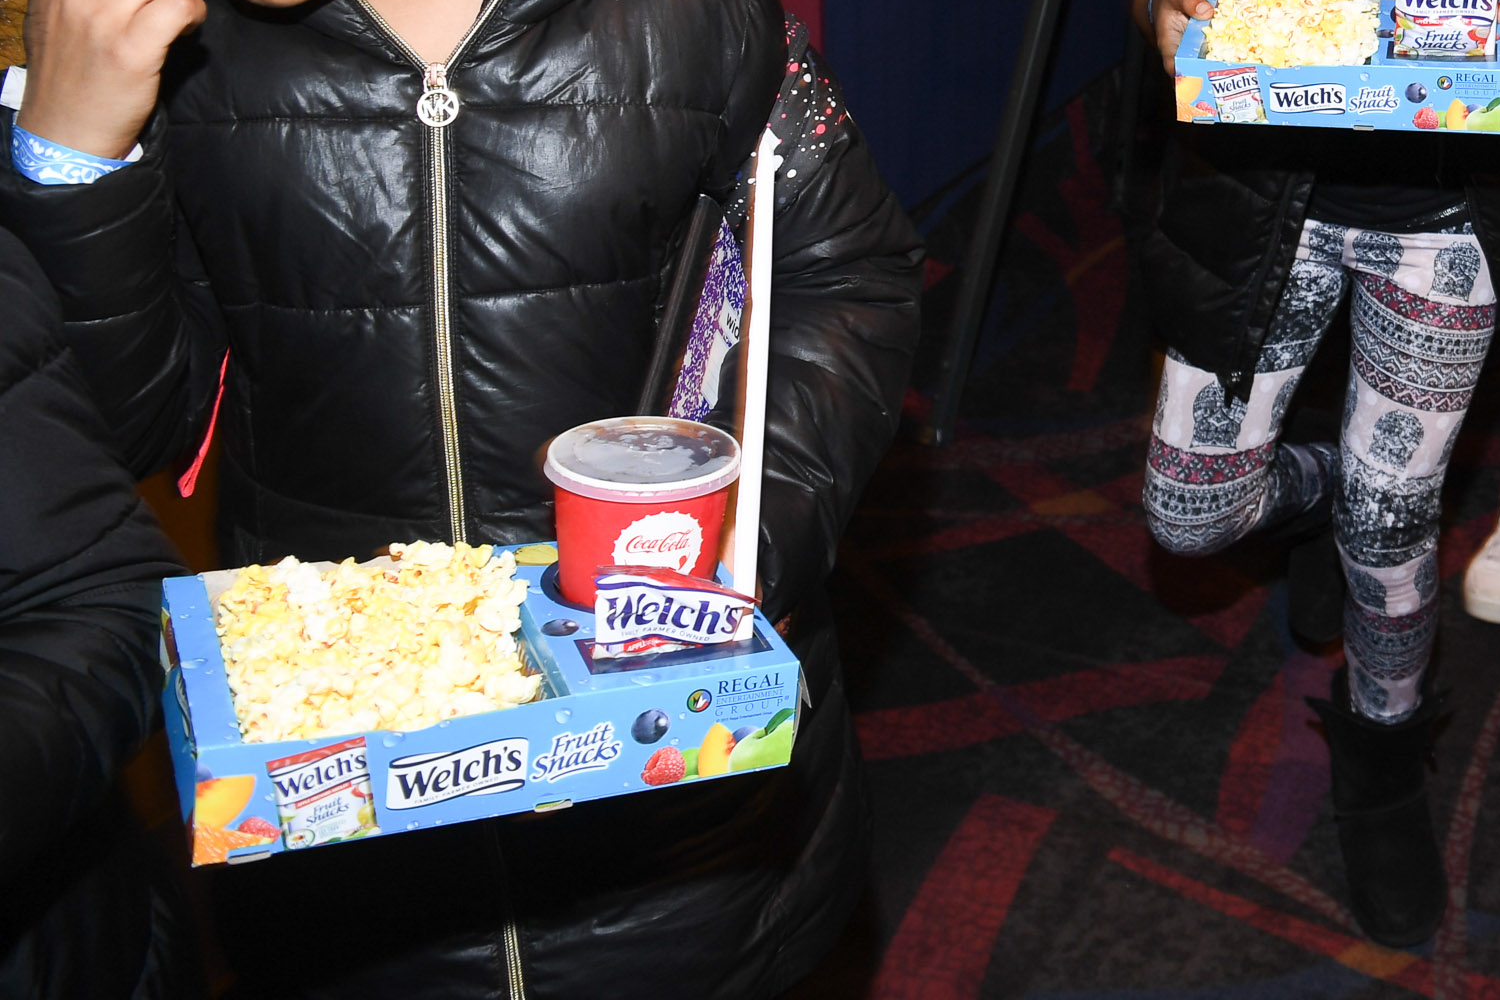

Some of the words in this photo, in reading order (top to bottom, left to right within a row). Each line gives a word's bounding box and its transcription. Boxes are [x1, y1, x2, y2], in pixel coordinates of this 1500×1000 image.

[1412, 36, 1469, 50] Snacks
[1425, 29, 1464, 42] Fruit
[1211, 74, 1259, 94] Welch's
[1455, 72, 1497, 83] REGAL
[1273, 87, 1343, 108] Welch's
[1359, 86, 1394, 100] Fruit
[1349, 96, 1399, 112] Snacks
[625, 527, 694, 554] Coca-Cola
[604, 593, 738, 635] Welch's
[642, 626, 677, 635] FARMER
[679, 631, 711, 642] OWNED
[718, 672, 785, 695] REGAL
[716, 688, 784, 704] ENTERTAINMENT
[714, 699, 784, 717] GROUP
[552, 723, 612, 757] Fruit
[532, 740, 618, 780] Snacks
[273, 753, 368, 798] Welch's
[395, 746, 522, 800] Welch's
[305, 804, 350, 827] Snacks
[313, 796, 342, 816] Fruit
